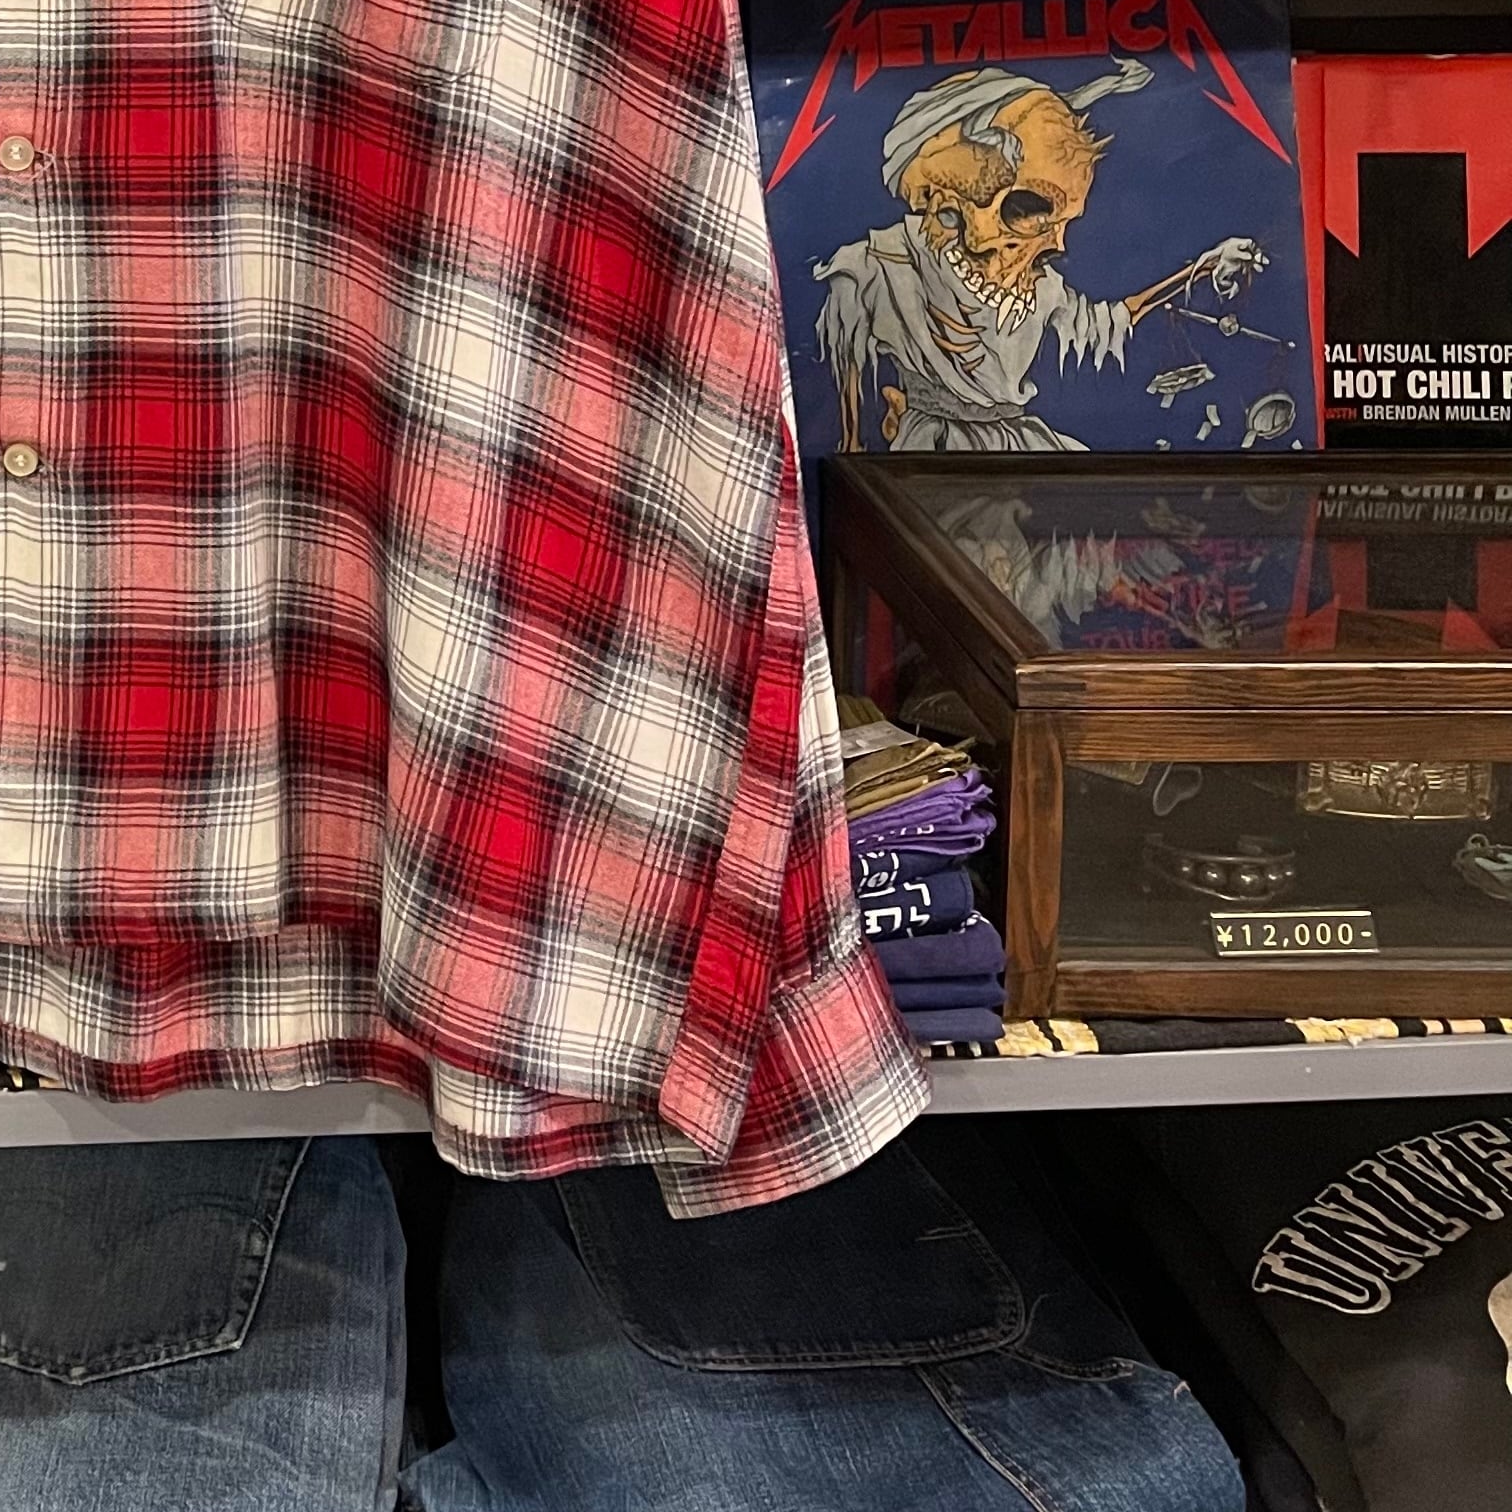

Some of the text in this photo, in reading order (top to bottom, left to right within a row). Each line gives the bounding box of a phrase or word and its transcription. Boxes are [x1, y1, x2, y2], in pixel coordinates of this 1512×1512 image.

[1333, 369, 1396, 399] HOT
[1407, 369, 1491, 400] CHILI
[1363, 405, 1440, 420] BRENDAN
[1445, 405, 1511, 421] MULLEN
[1216, 923, 1372, 948] ¥12,000-
[1252, 1118, 1512, 1314] UNIVE
